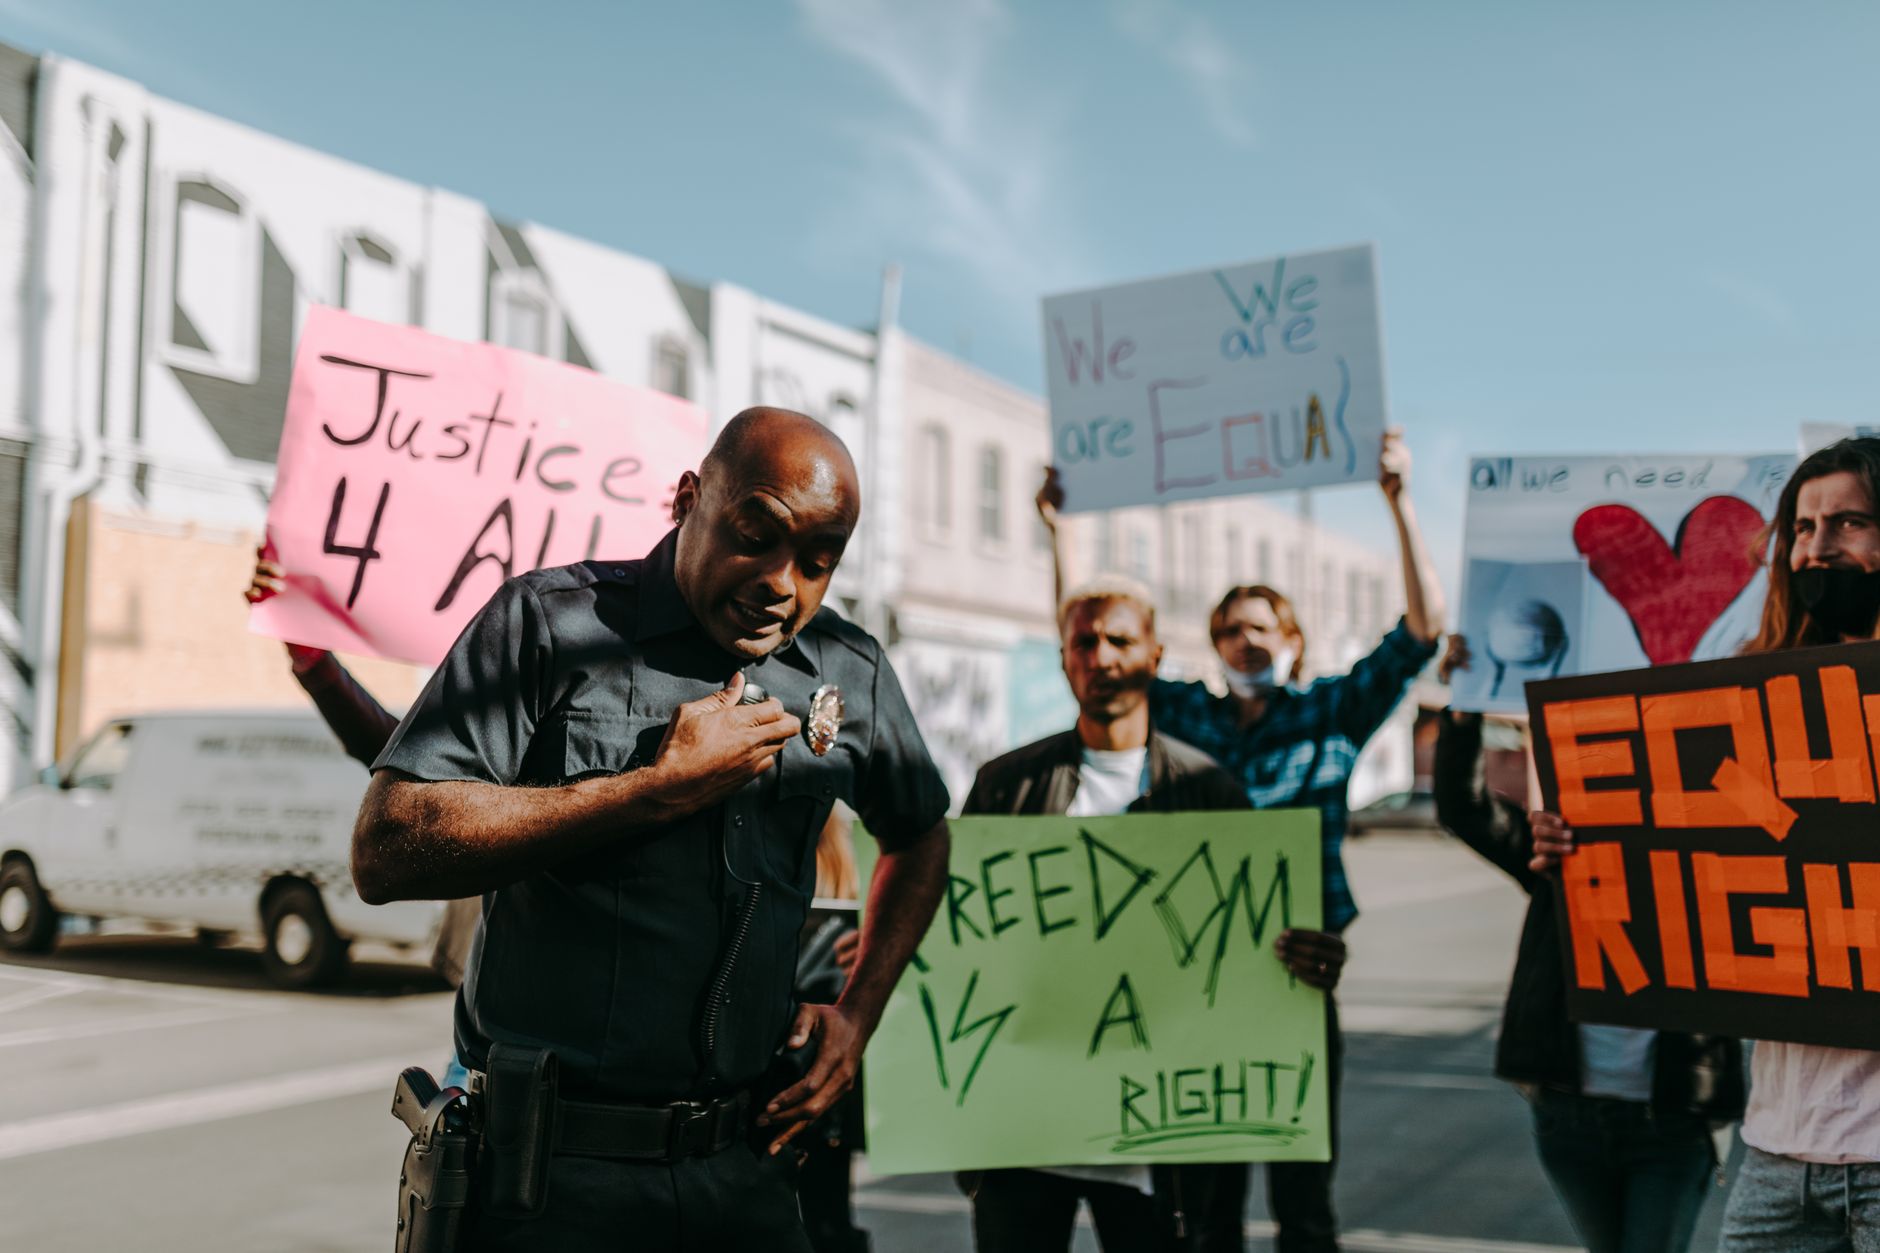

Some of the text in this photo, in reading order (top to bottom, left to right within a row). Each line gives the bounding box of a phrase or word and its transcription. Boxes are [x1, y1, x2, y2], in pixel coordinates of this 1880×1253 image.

[1211, 256, 1320, 323] We
[1053, 299, 1138, 385] We
[1219, 315, 1320, 361] are
[319, 354, 646, 506] Justice
[1056, 416, 1136, 463] are
[1472, 457, 1512, 491] all
[1520, 464, 1570, 494] we
[1603, 460, 1712, 492] need
[322, 475, 390, 611] 4
[1543, 664, 1880, 842] EQU
[945, 828, 1298, 1009] REEDOM
[1087, 972, 1152, 1059] A
[1120, 1050, 1315, 1137] RIGHT!
